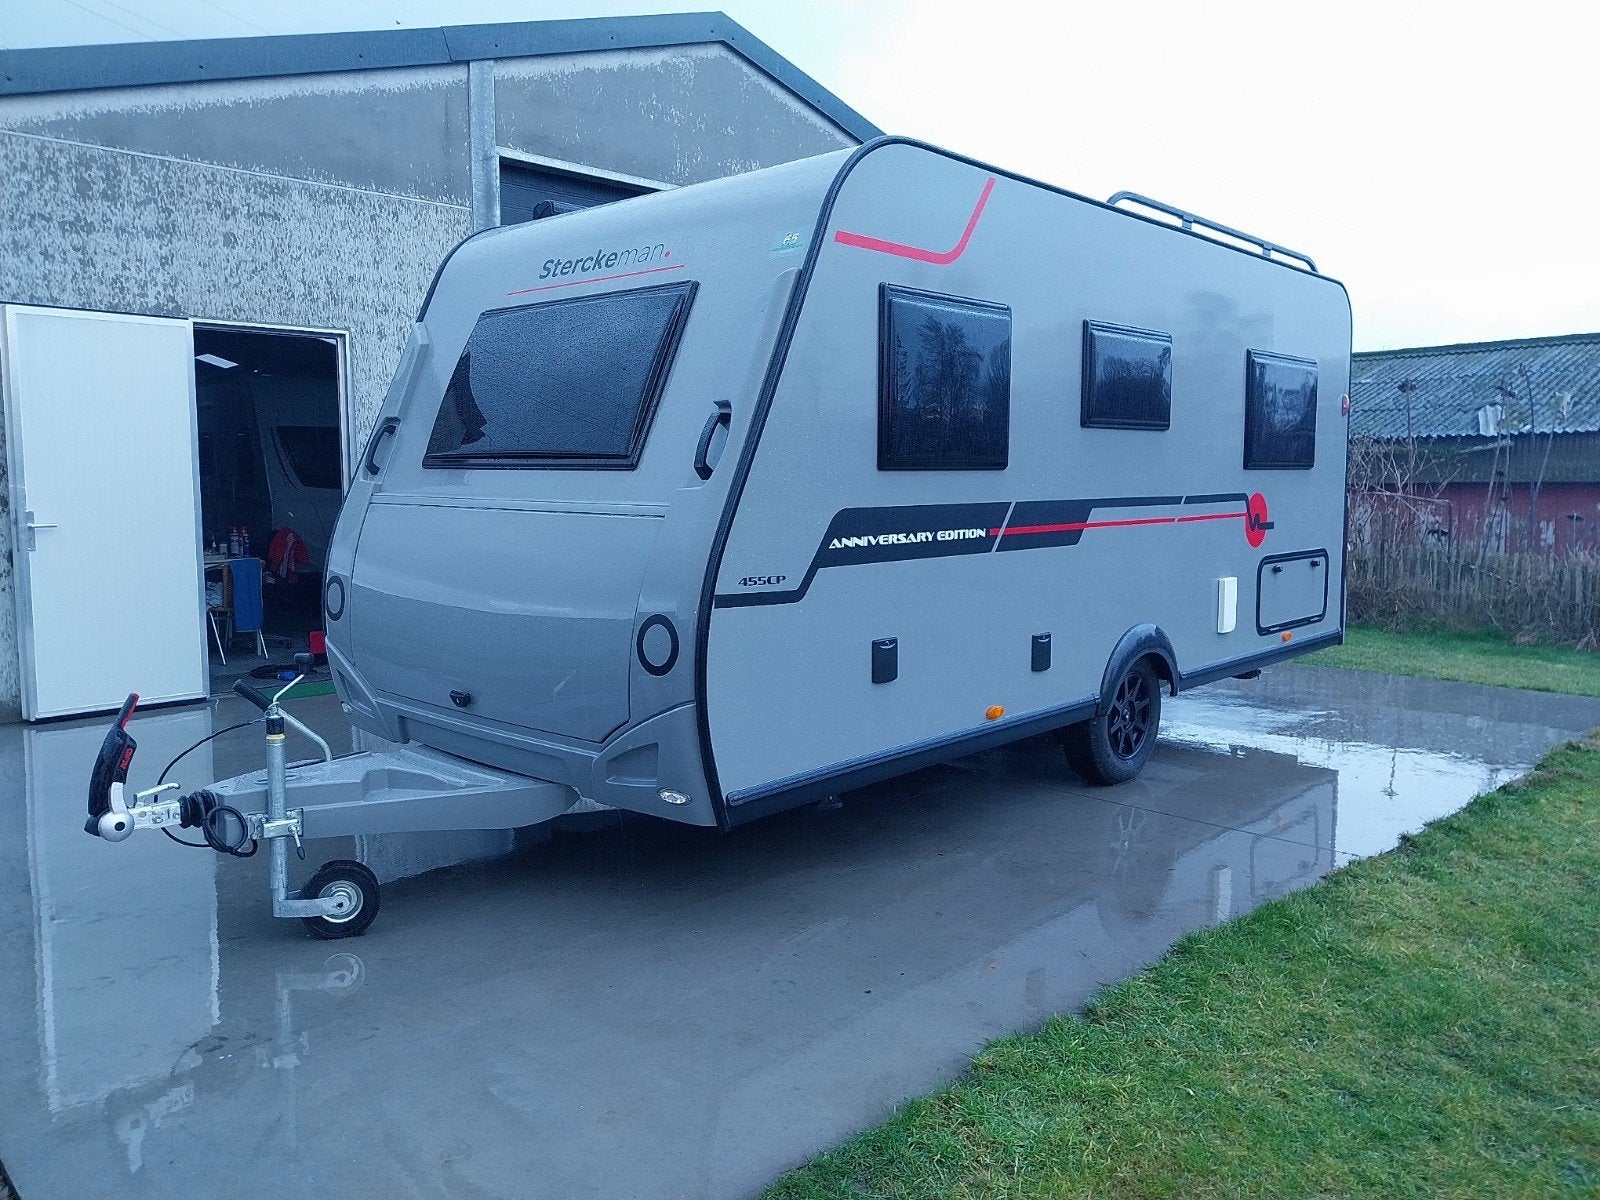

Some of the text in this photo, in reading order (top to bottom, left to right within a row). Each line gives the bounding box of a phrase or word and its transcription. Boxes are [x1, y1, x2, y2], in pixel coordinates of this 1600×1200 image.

[828, 528, 986, 549] ANNIVERSARY EDITION
[738, 575, 787, 587] 455CP
